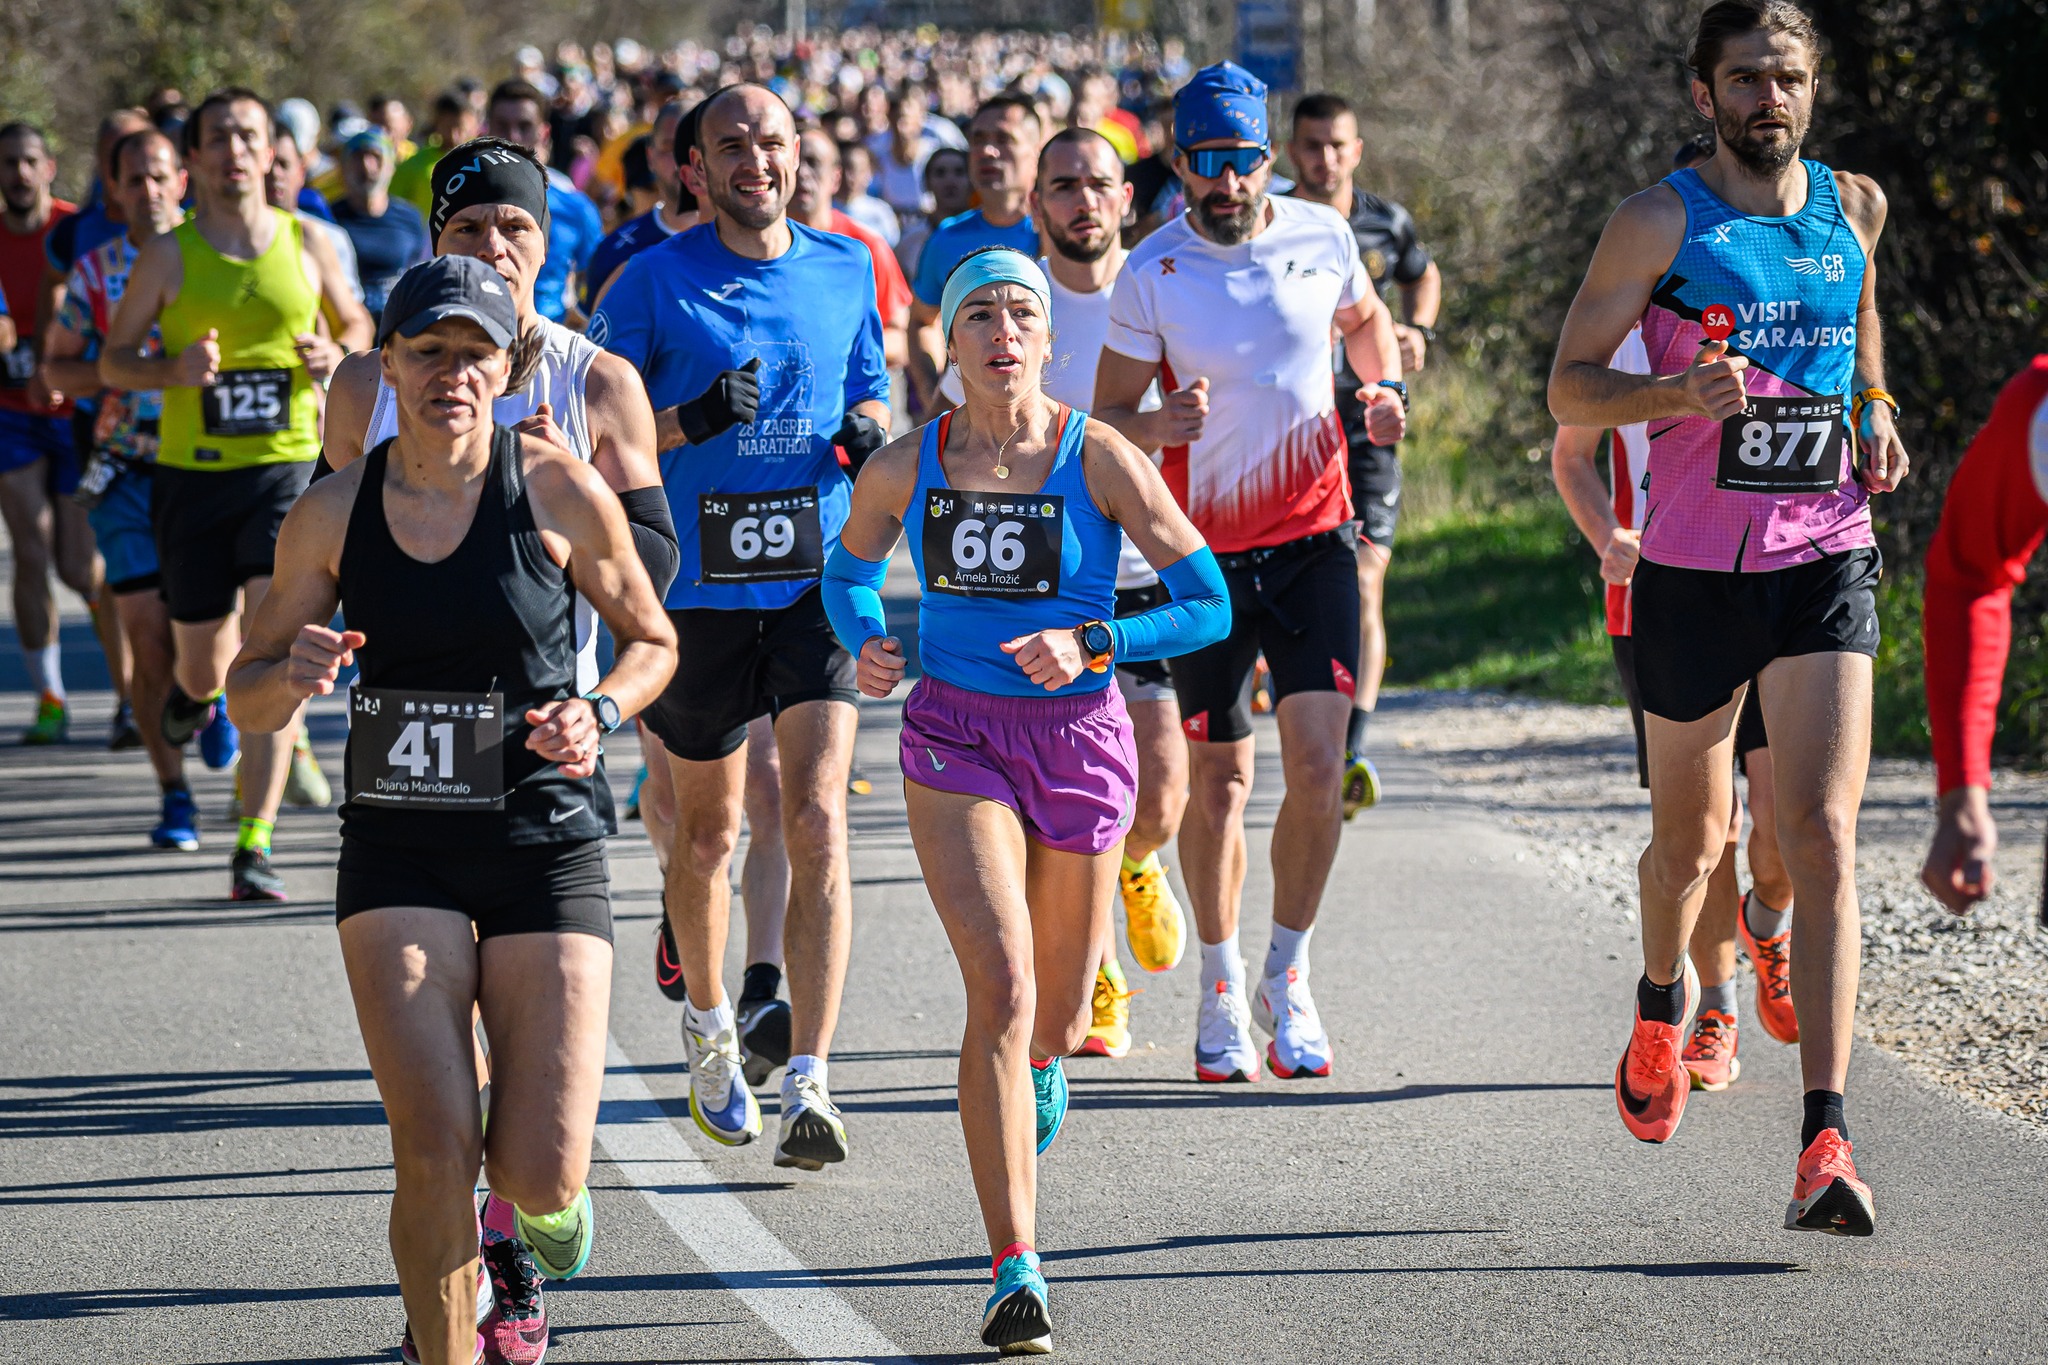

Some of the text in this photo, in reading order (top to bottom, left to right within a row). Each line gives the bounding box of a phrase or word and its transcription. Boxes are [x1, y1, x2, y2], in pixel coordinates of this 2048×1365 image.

[1821, 254, 1844, 270] CR
[1823, 270, 1845, 282] 387
[1707, 313, 1729, 327] SA
[1737, 301, 1801, 323] VISIT
[1738, 325, 1854, 350] SARAJEVO
[213, 383, 281, 421] 125
[763, 418, 813, 436] ZAGREB
[737, 438, 811, 456] MARATHON
[1738, 420, 1832, 466] 877
[730, 514, 795, 560] 69
[952, 518, 1026, 572] 66
[954, 571, 1020, 585] Amela Trožić
[387, 721, 454, 778] 41
[376, 778, 409, 792] Dijana
